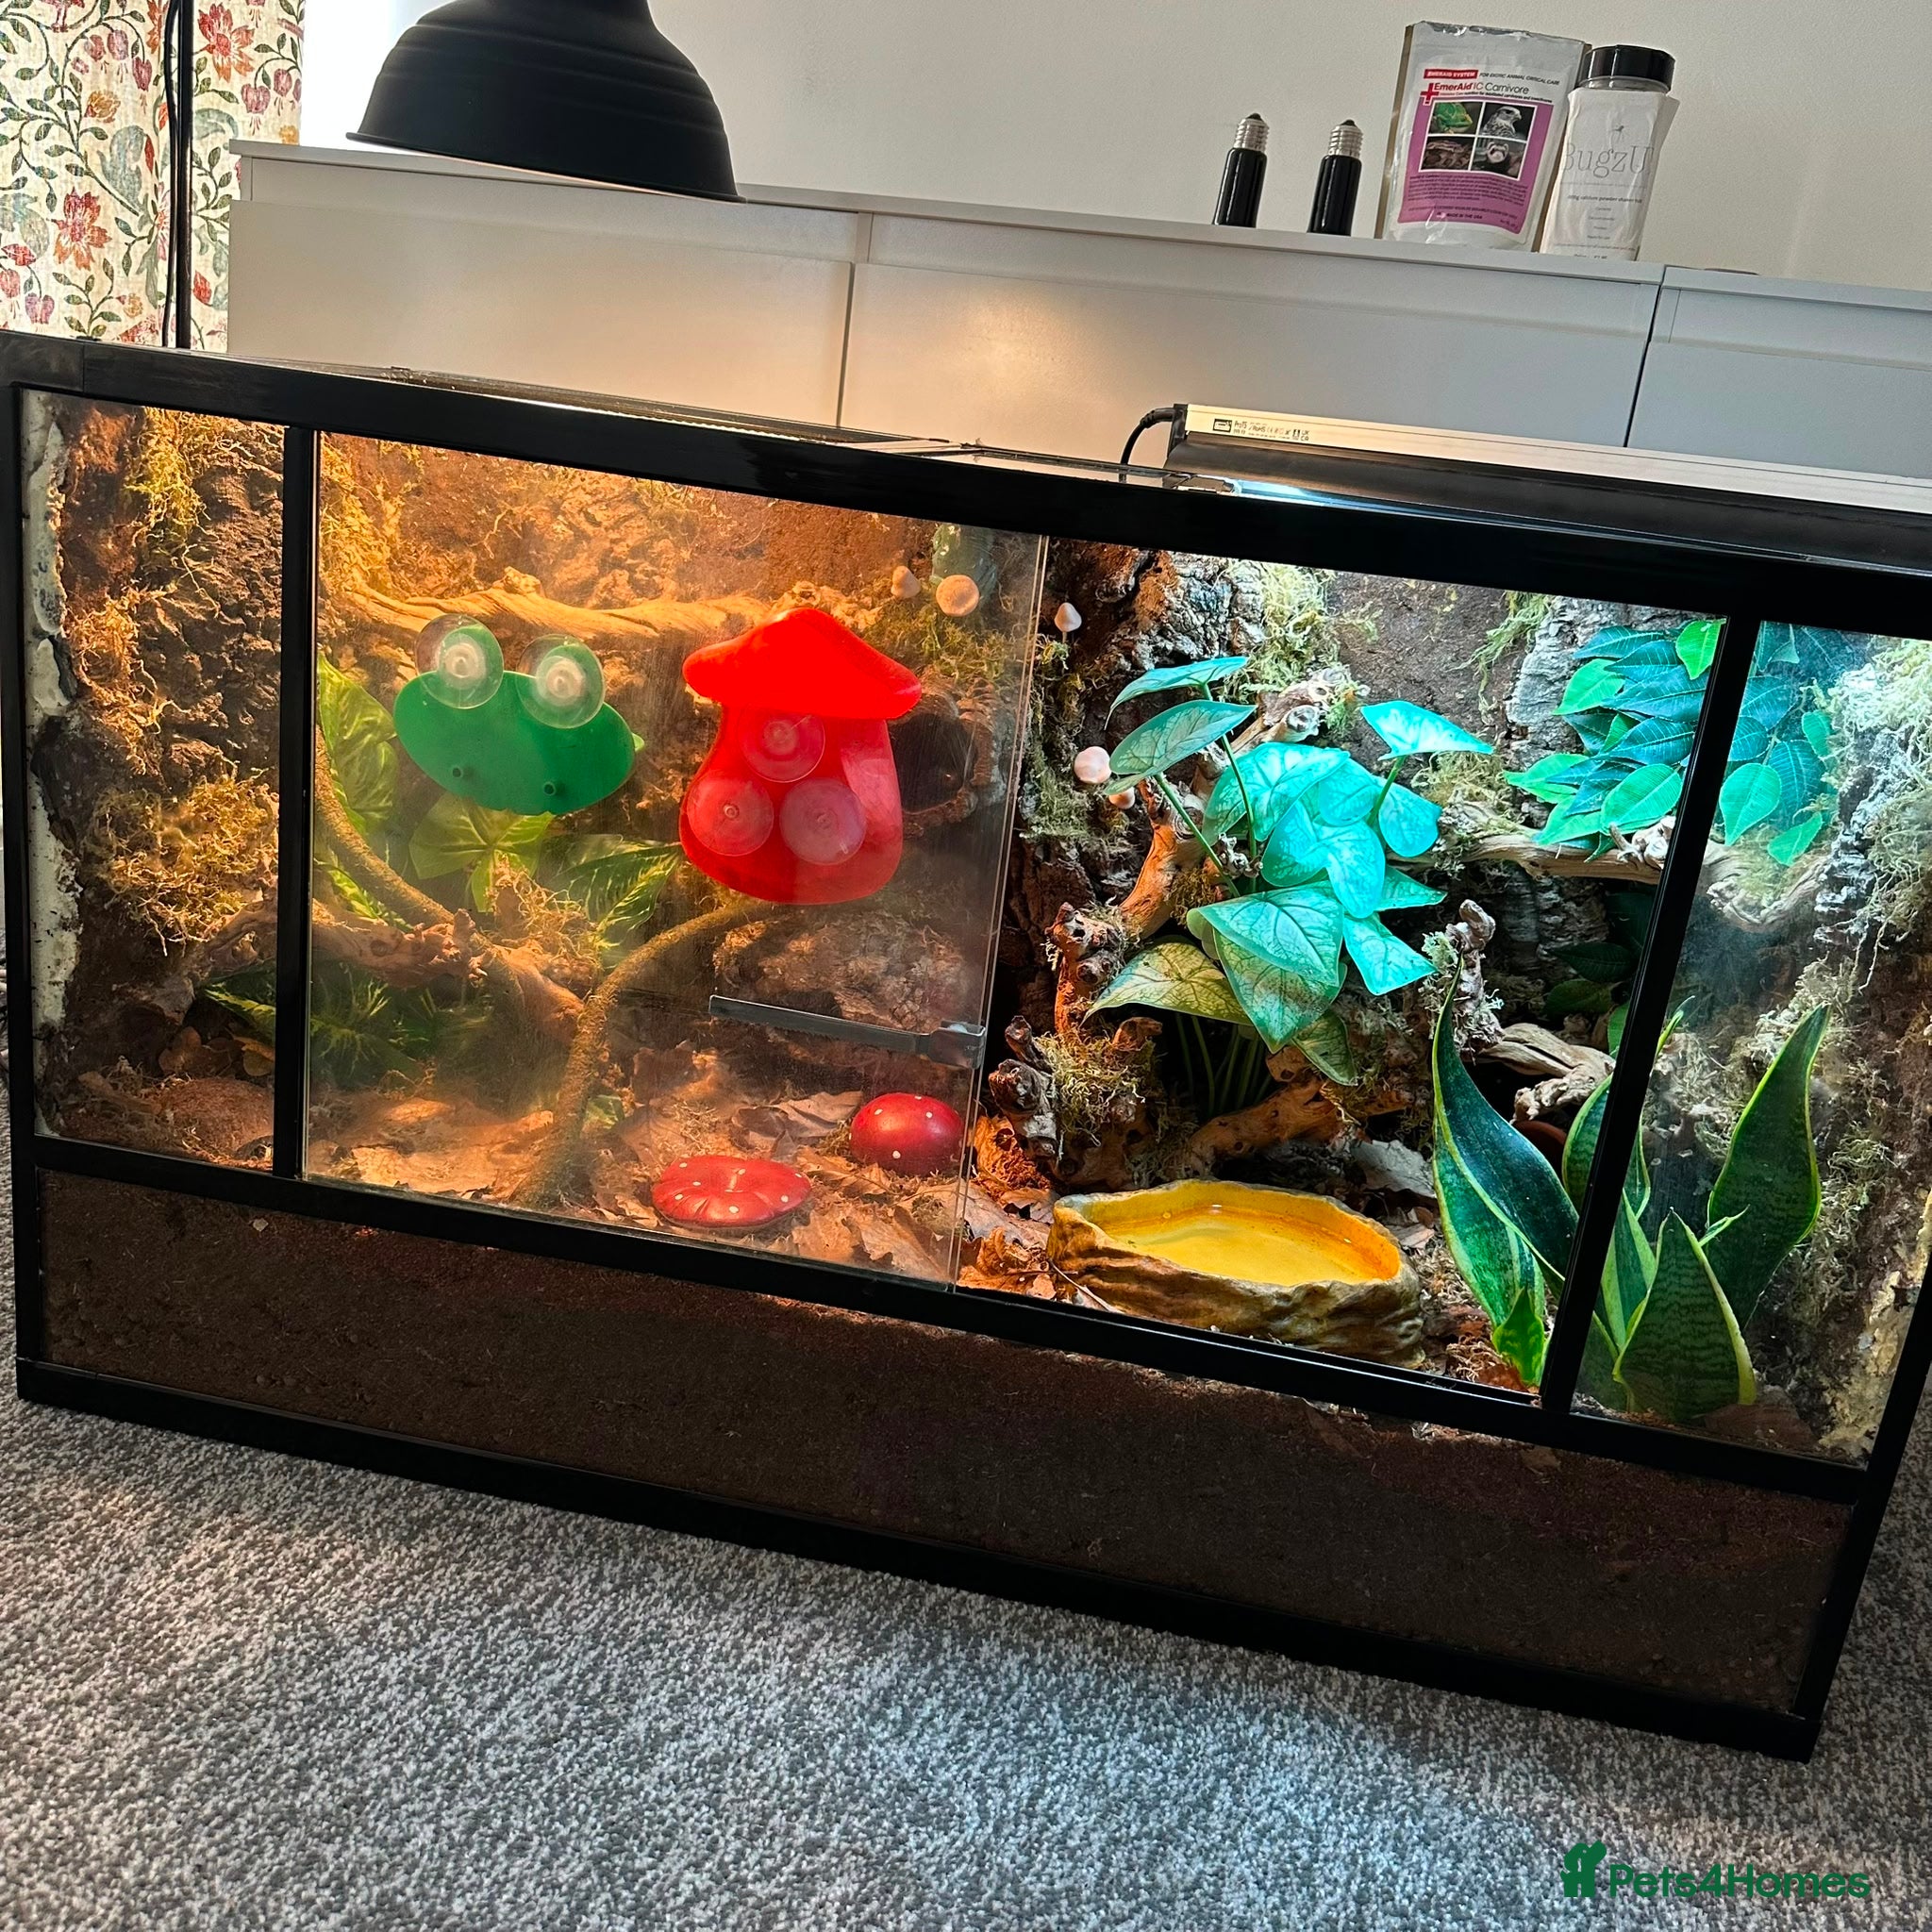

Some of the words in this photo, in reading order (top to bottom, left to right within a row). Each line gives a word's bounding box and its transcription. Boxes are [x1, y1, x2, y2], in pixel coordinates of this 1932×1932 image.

[1525, 75, 1545, 84] CRITICAL
[1434, 82, 1473, 91] EmerAid
[1474, 82, 1484, 91] IC
[1485, 82, 1530, 94] Carnivore
[1564, 142, 1655, 178] BugzU
